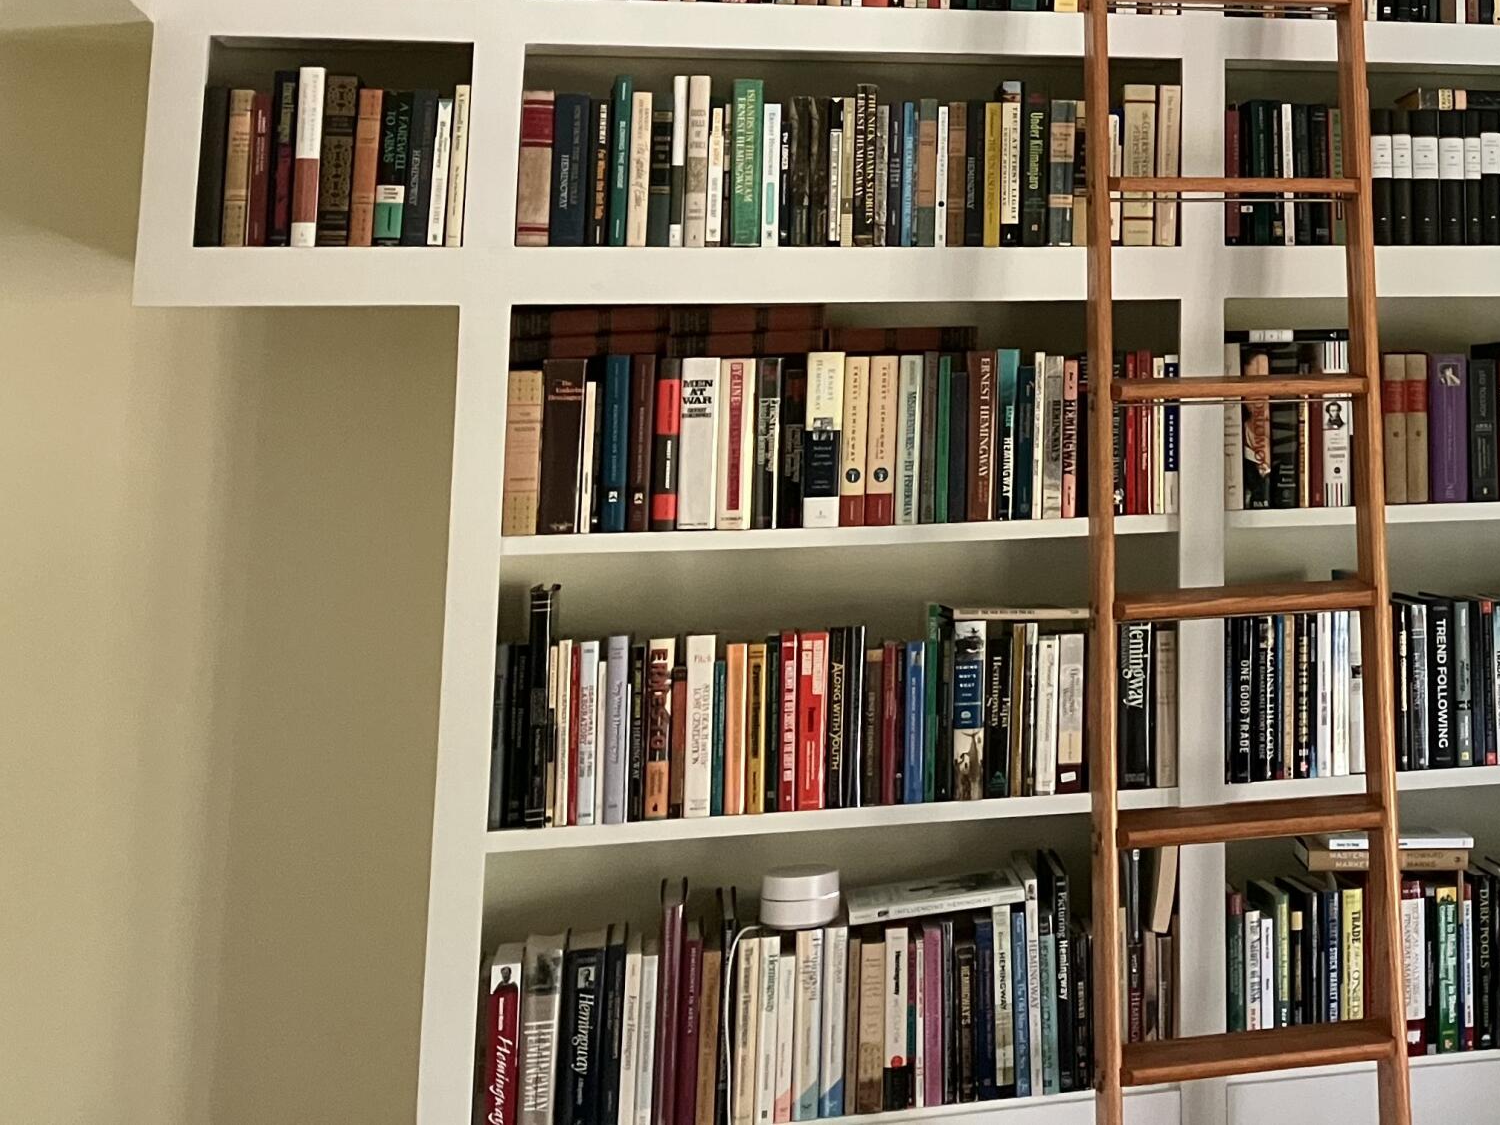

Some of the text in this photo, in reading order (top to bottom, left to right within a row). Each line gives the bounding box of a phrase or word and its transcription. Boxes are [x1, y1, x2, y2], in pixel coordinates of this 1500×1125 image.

[383, 111, 397, 163] TO ARMS
[393, 102, 409, 171] A FAREWELL
[435, 121, 446, 169] Hemingway
[599, 104, 608, 144] HEMINGWAY
[734, 97, 746, 195] ERNEST HEMINGWAY
[743, 89, 756, 202] ISLANDS IN THE STREAM
[854, 93, 866, 198] ERNEST HEMINGWAY
[1028, 112, 1043, 190] Under Kilimanjaro
[409, 149, 421, 206] HEMINGWAY
[559, 154, 569, 210] HEMINGWAY
[865, 94, 877, 225] THE NICK ADAMS STORIES
[965, 156, 976, 210] HEMINGWAY
[682, 396, 712, 405] WAR
[683, 380, 713, 389] MEN
[690, 388, 706, 396] AT
[977, 358, 991, 477] ERNEST HEMINGWAY
[1002, 437, 1013, 498] HEMINGWAY
[1063, 399, 1077, 475] HEMINGWAY
[1167, 414, 1175, 469] HEMINGWAY
[648, 647, 669, 751] ERNESTO
[830, 662, 844, 770] ALONG WITH YOUTH
[987, 656, 1002, 728] Hemingway
[1239, 659, 1250, 753] ONE GOOD TRADE
[1435, 618, 1450, 748] TREND FOLLOWING
[1055, 892, 1070, 1000] Picturing Hemingway
[1351, 910, 1361, 944] TRADE
[1479, 889, 1490, 968] DARK POOLS
[764, 954, 779, 1013] Hemingway
[893, 950, 903, 996] Hemingway
[998, 951, 1007, 1011] HEMINGWAY
[1028, 938, 1039, 1009] HEMINGWAY
[1328, 947, 1338, 1000] STOCK MARKET
[524, 1021, 556, 1113] HEMINGWAY
[573, 992, 594, 1075] Hemingway
